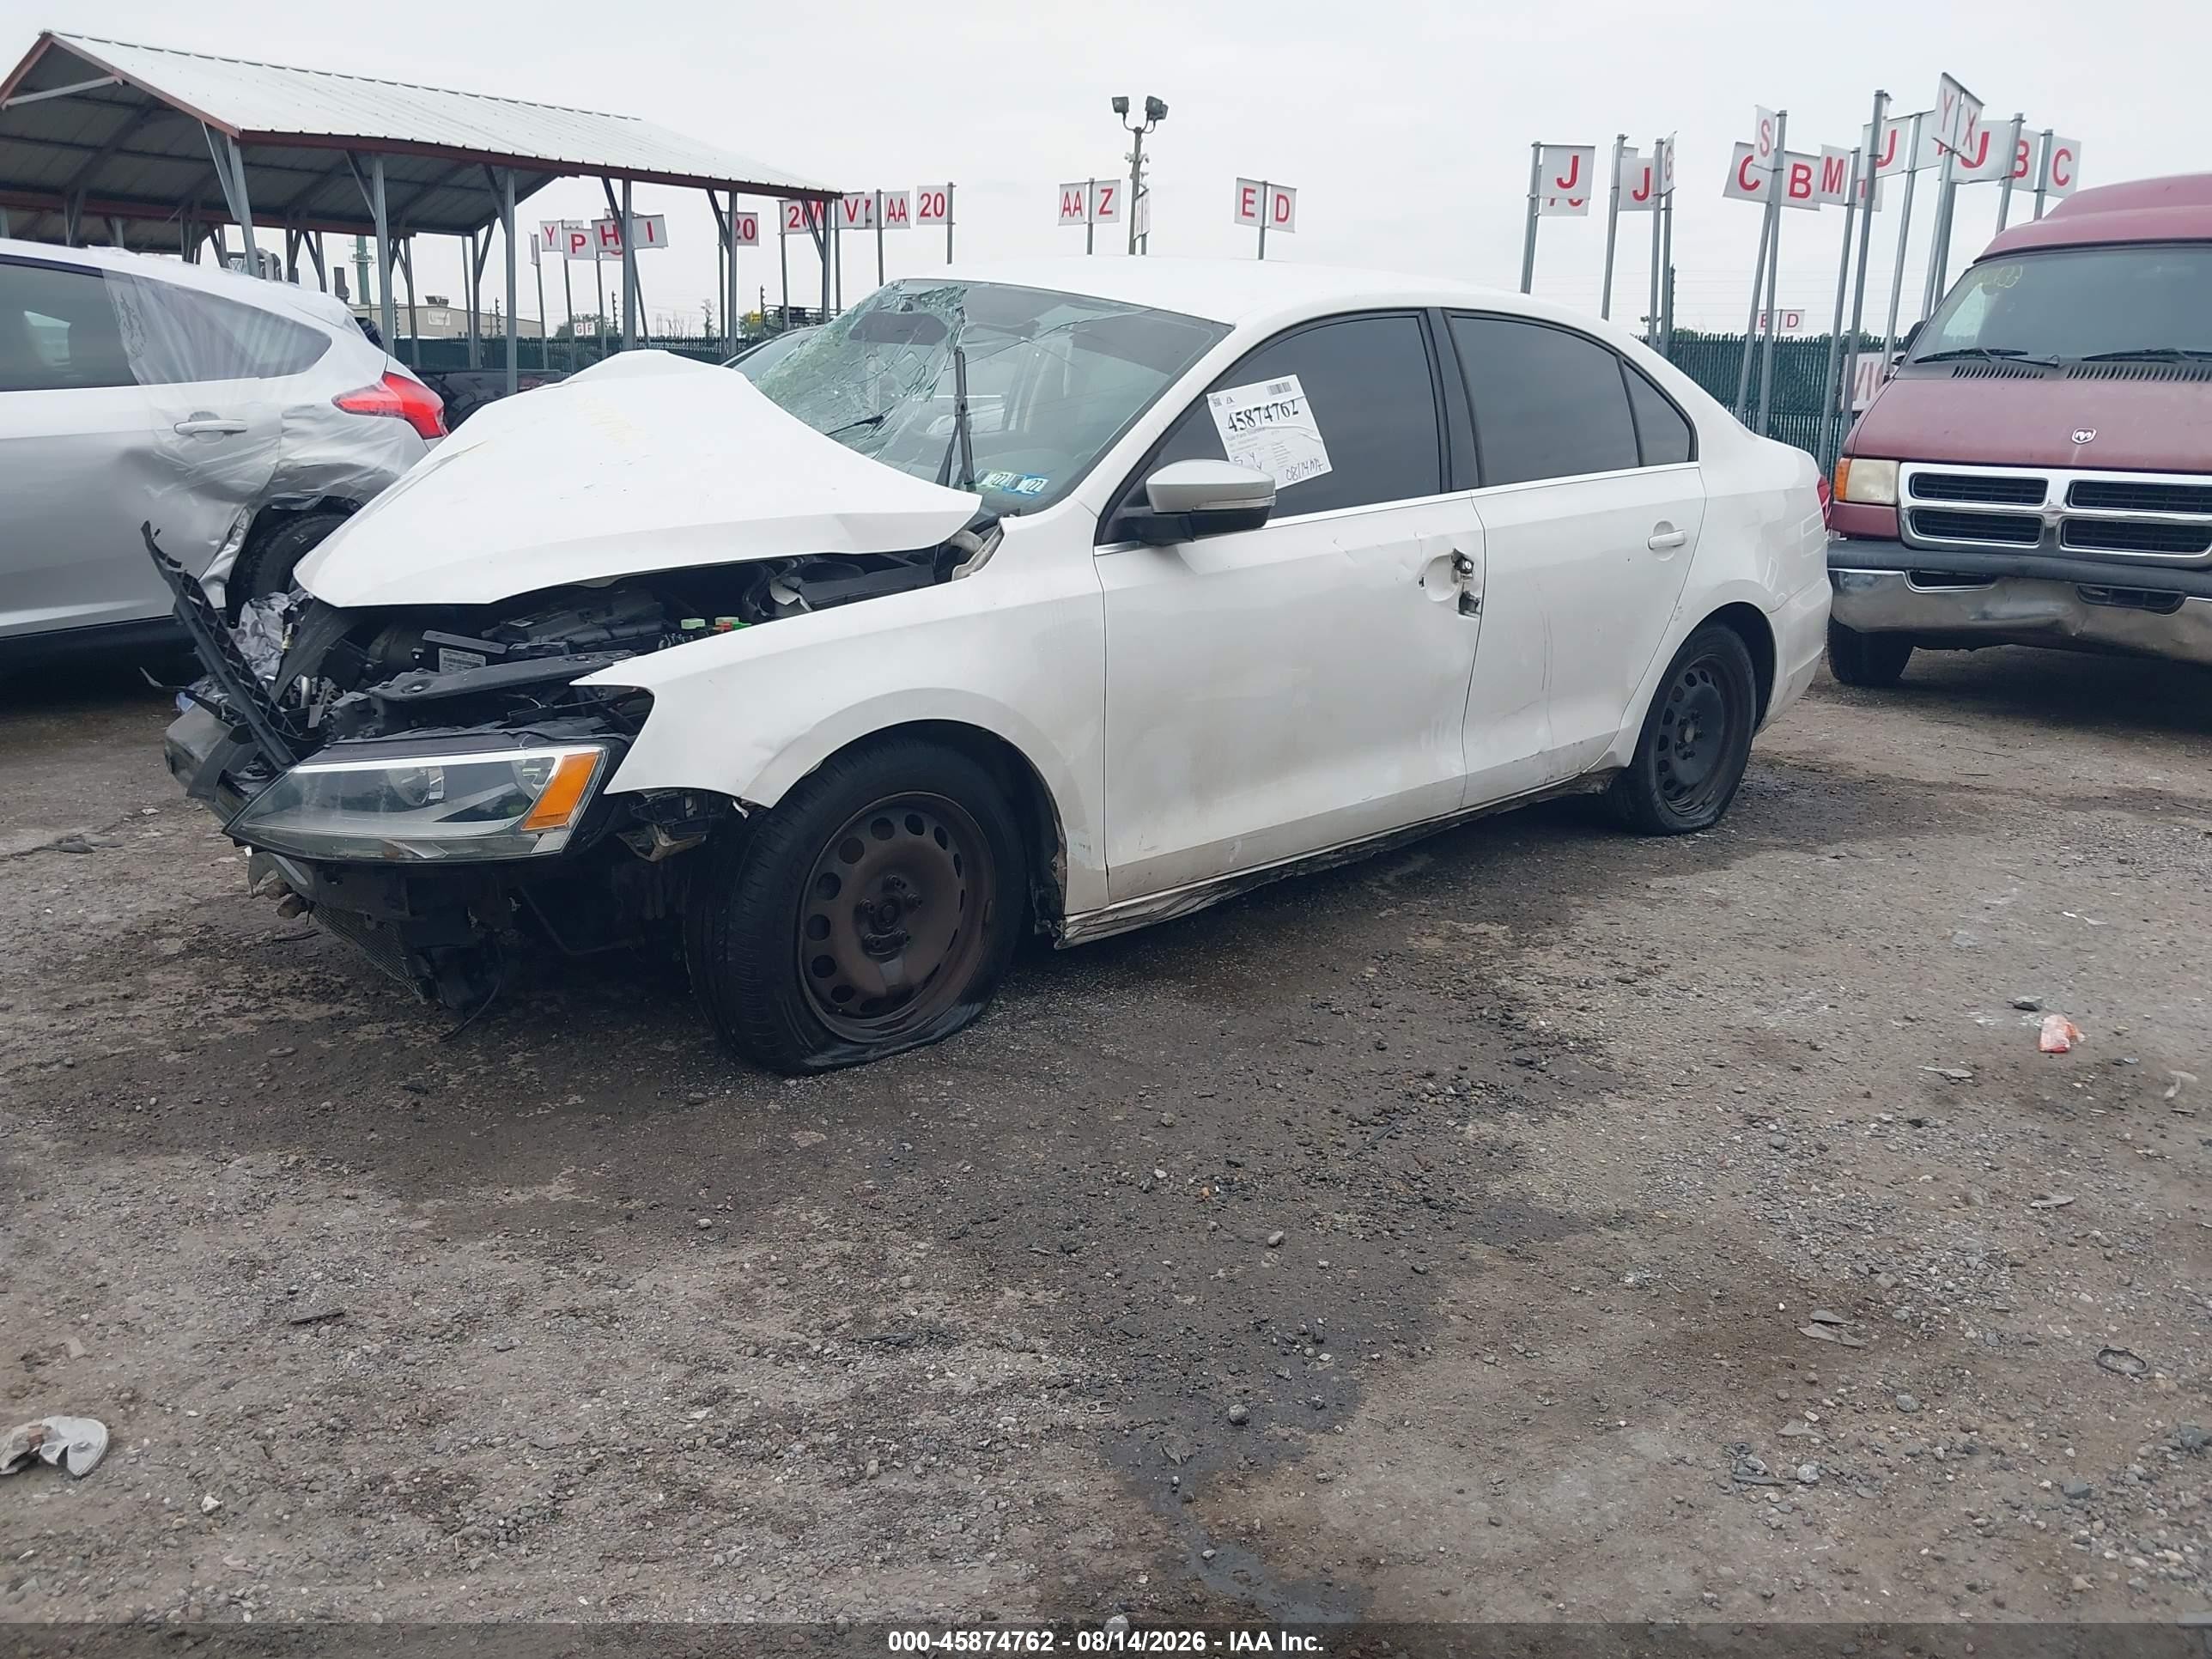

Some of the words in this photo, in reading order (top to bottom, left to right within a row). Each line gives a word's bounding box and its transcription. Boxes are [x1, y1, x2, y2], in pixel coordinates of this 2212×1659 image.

[1942, 88, 1955, 133] Y
[1759, 118, 1771, 158] S
[1962, 106, 1978, 152] X
[1875, 128, 1898, 168] J
[1960, 131, 1990, 169] J
[1556, 155, 1579, 189] J
[1738, 155, 1761, 191] C
[1789, 162, 1813, 199] B
[1821, 155, 1844, 195] M
[2052, 148, 2072, 187] C
[1632, 167, 1650, 202] J
[843, 199, 860, 222] V
[886, 198, 908, 222] AA
[919, 191, 945, 218] 20
[1060, 191, 1084, 218] AA
[1098, 188, 1114, 215] Z
[1242, 187, 1256, 218] E
[1274, 193, 1290, 222] D
[544, 226, 556, 246] Y
[570, 233, 586, 254] P
[600, 224, 620, 247] H
[646, 221, 655, 243] I
[1786, 313, 1800, 328] D
[1227, 398, 1299, 433] 45874762
